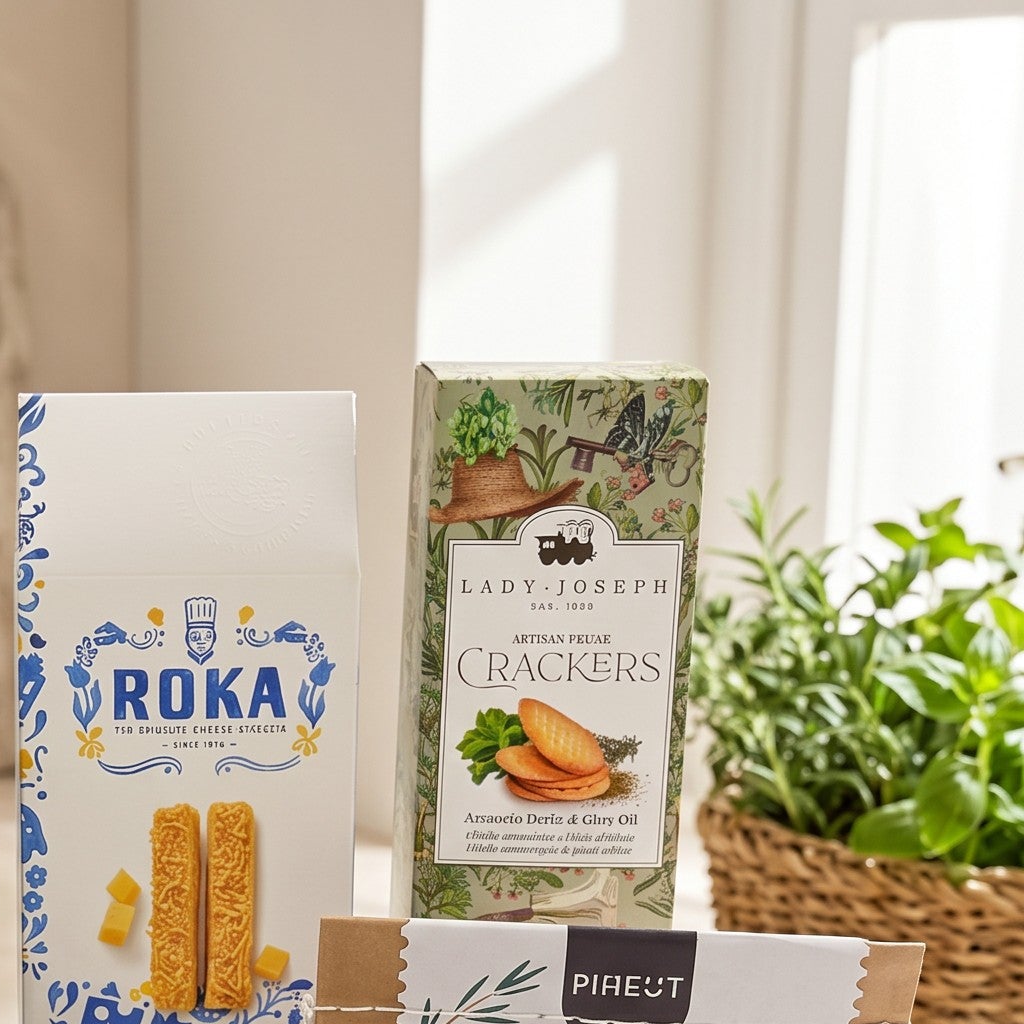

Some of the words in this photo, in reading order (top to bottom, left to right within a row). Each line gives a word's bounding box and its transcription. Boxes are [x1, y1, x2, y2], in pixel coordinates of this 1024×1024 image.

[461, 579, 536, 594] LADY
[557, 579, 668, 596] JOSEPH
[512, 634, 565, 645] ARTISAN
[457, 647, 661, 691] CRACKERS
[113, 666, 288, 721] ROKA
[193, 725, 233, 735] CHEESE
[173, 741, 199, 749] SINCE
[618, 814, 638, 826] Oil
